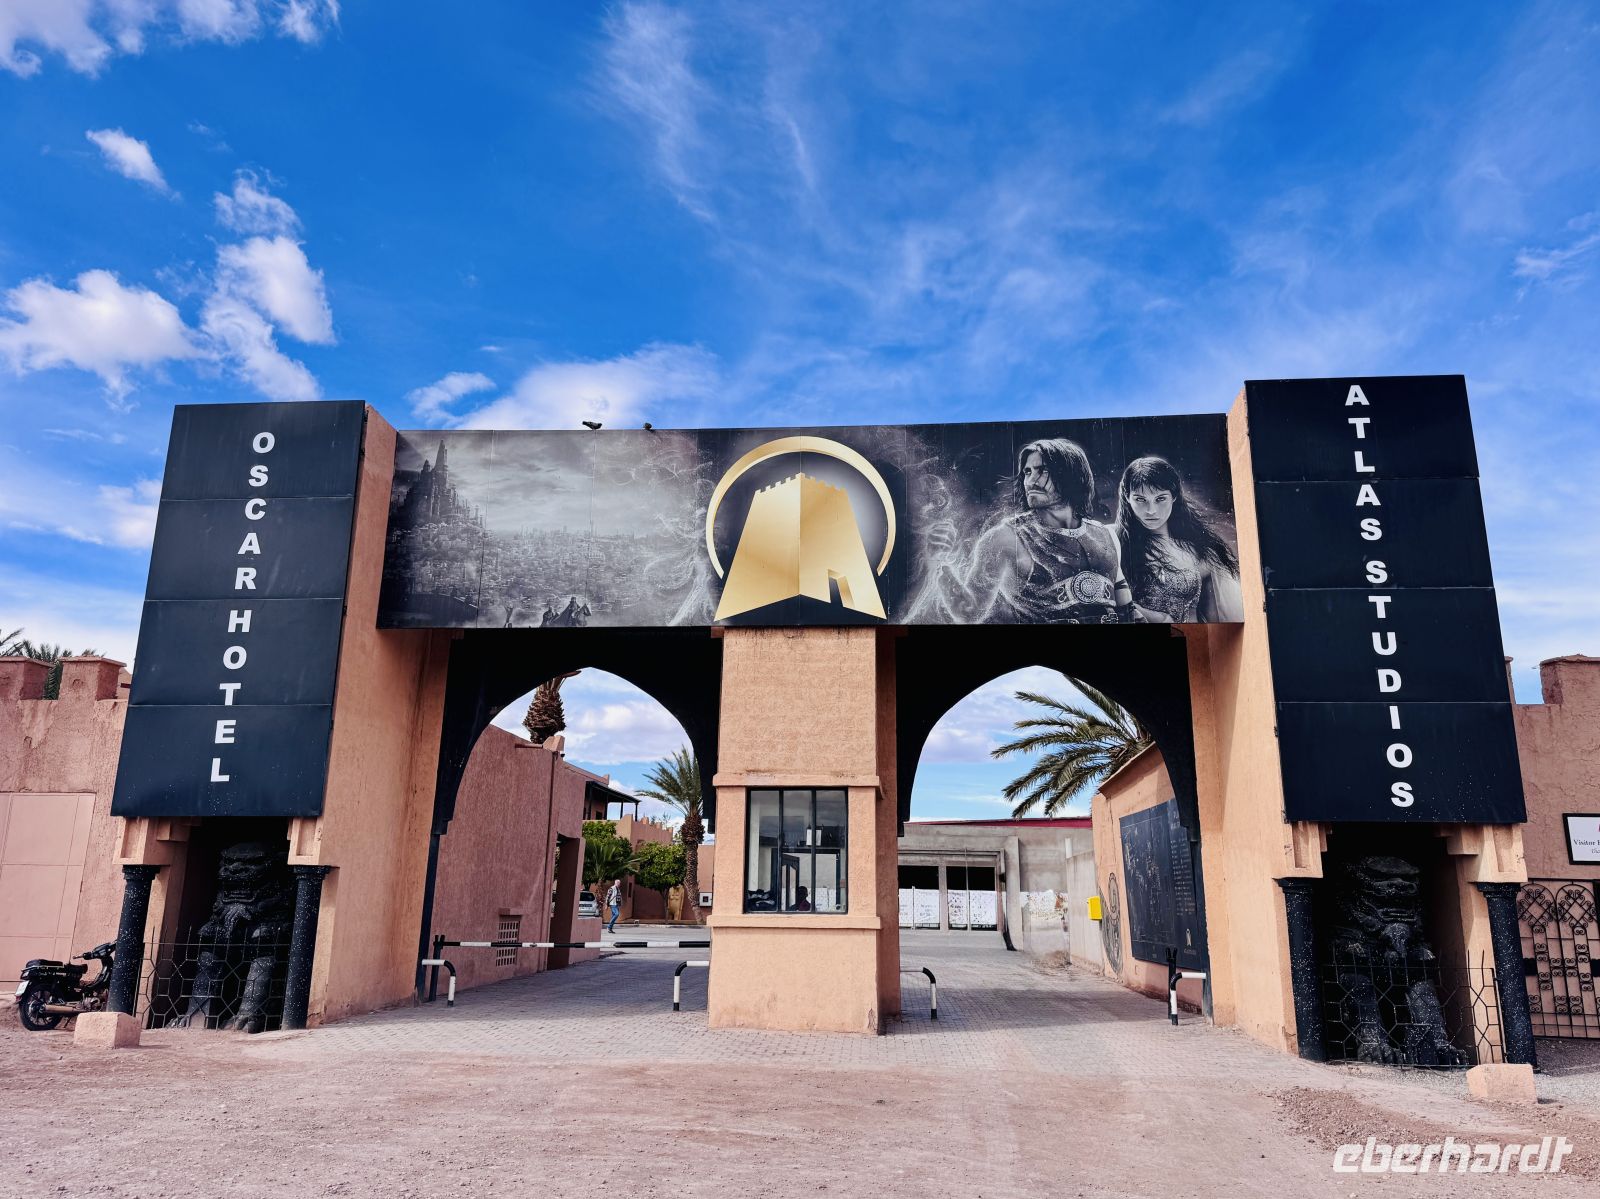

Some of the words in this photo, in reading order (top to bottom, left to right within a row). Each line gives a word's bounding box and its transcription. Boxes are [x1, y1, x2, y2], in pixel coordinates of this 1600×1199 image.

[234, 431, 276, 590] OSCAR
[1345, 384, 1383, 541] ATLAS
[1365, 560, 1415, 808] STUDIOS
[210, 609, 253, 783] HOTEL
